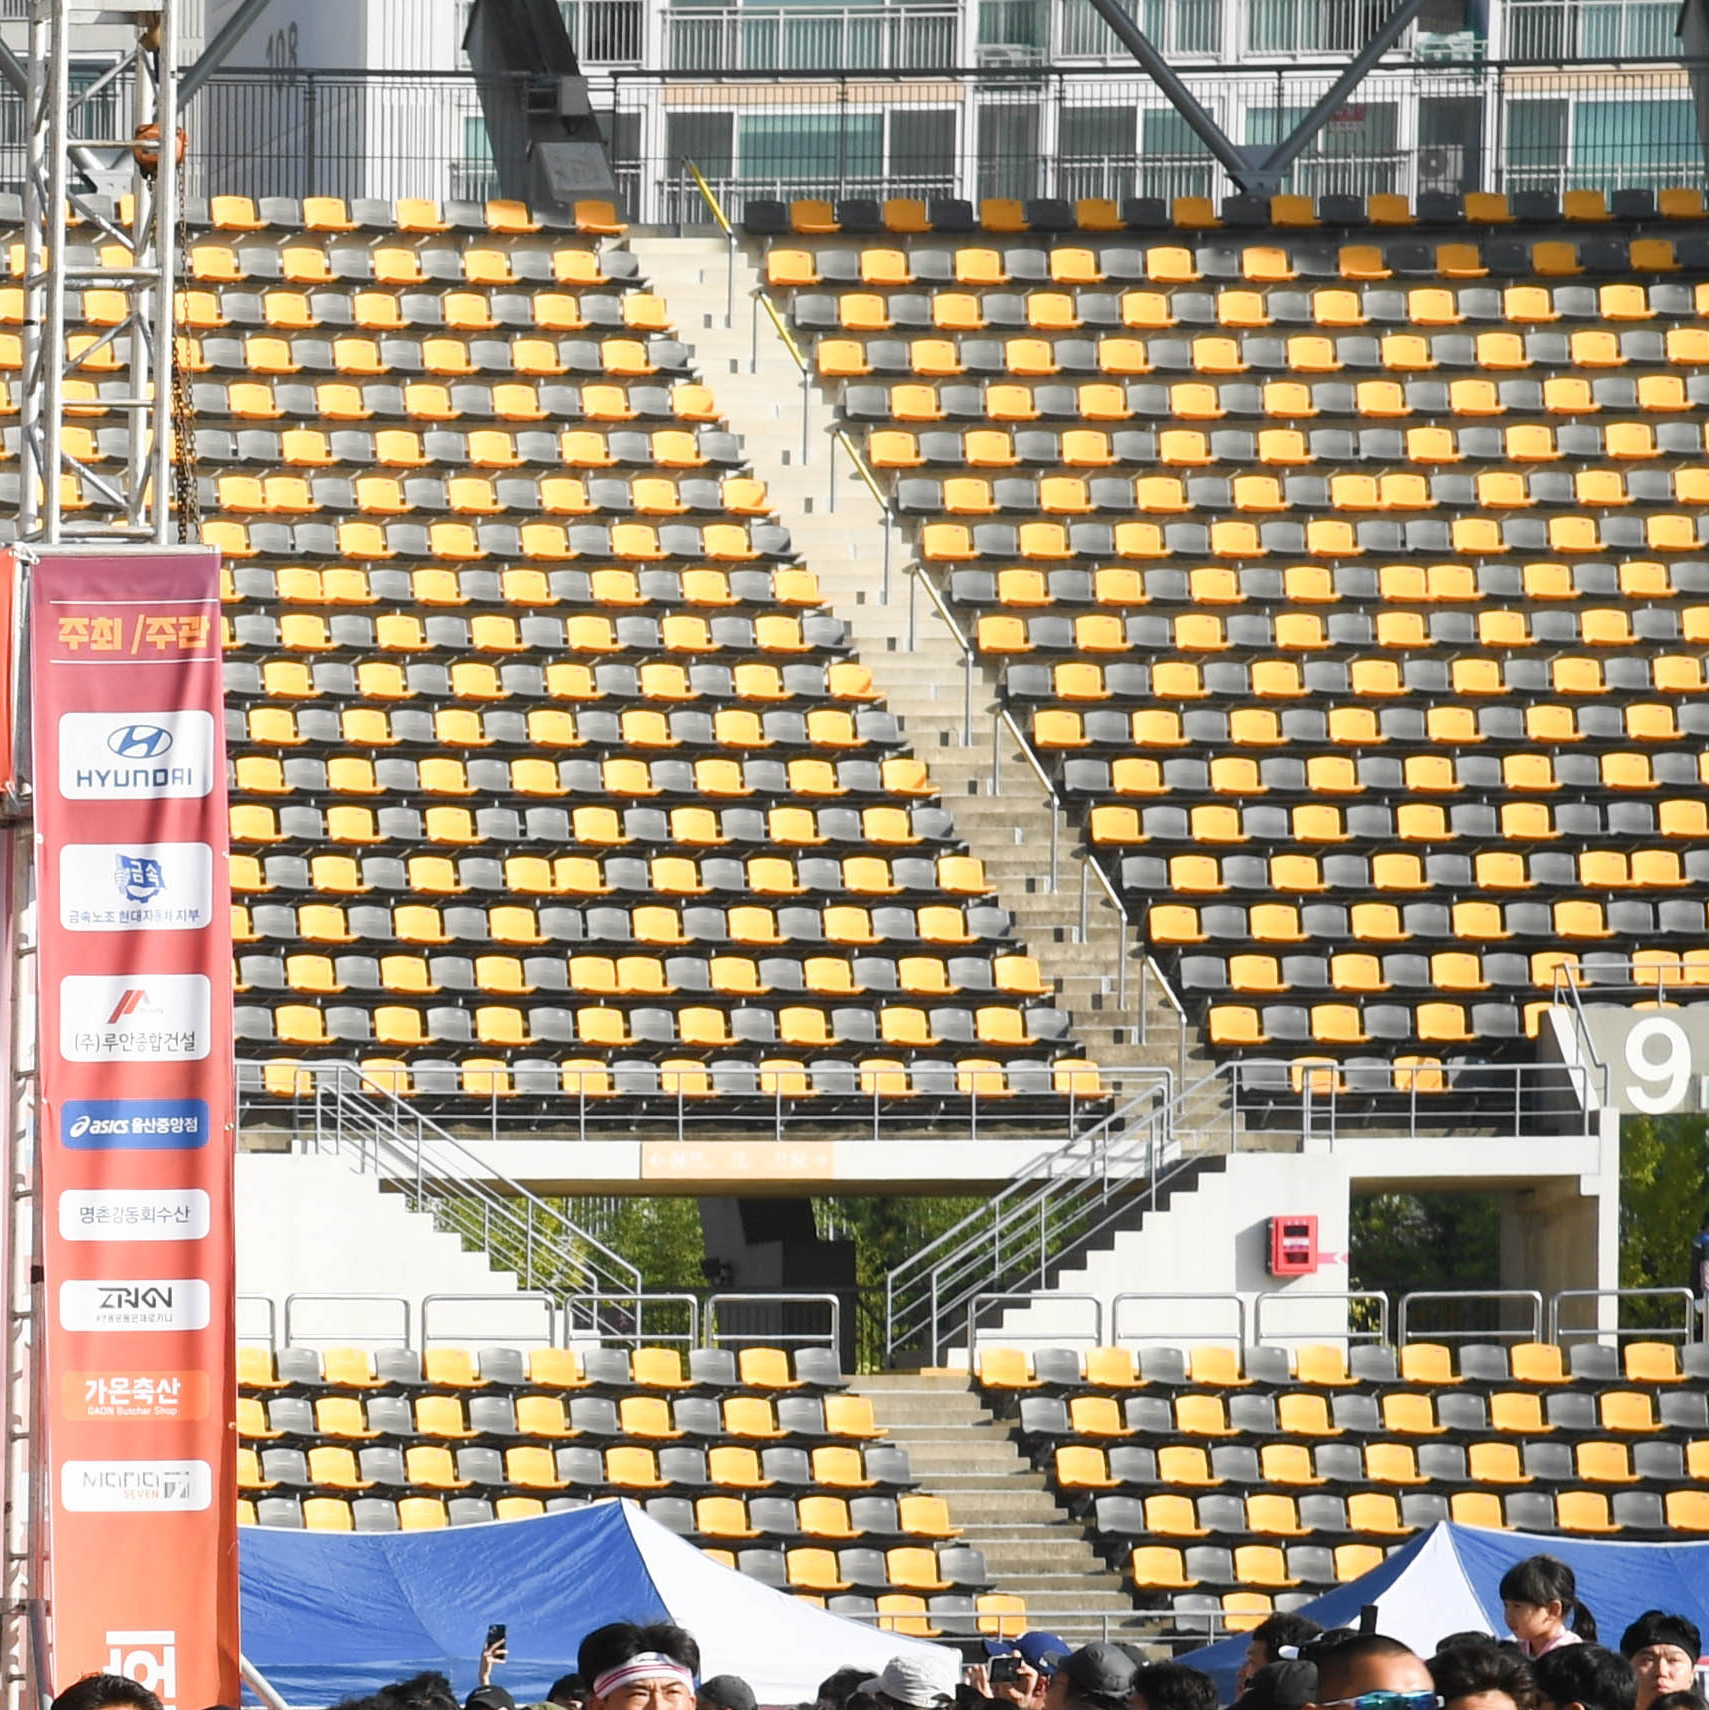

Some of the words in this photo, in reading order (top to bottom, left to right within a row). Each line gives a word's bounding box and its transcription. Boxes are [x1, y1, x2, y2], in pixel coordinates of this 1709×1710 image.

[77, 769, 191, 788] HYUNDAI
[68, 910, 116, 924] 금속노조
[1624, 1017, 1693, 1115] 9
[89, 1118, 129, 1135] asics
[131, 1116, 198, 1134] 울산중앙점
[84, 1376, 182, 1405] 가온축산
